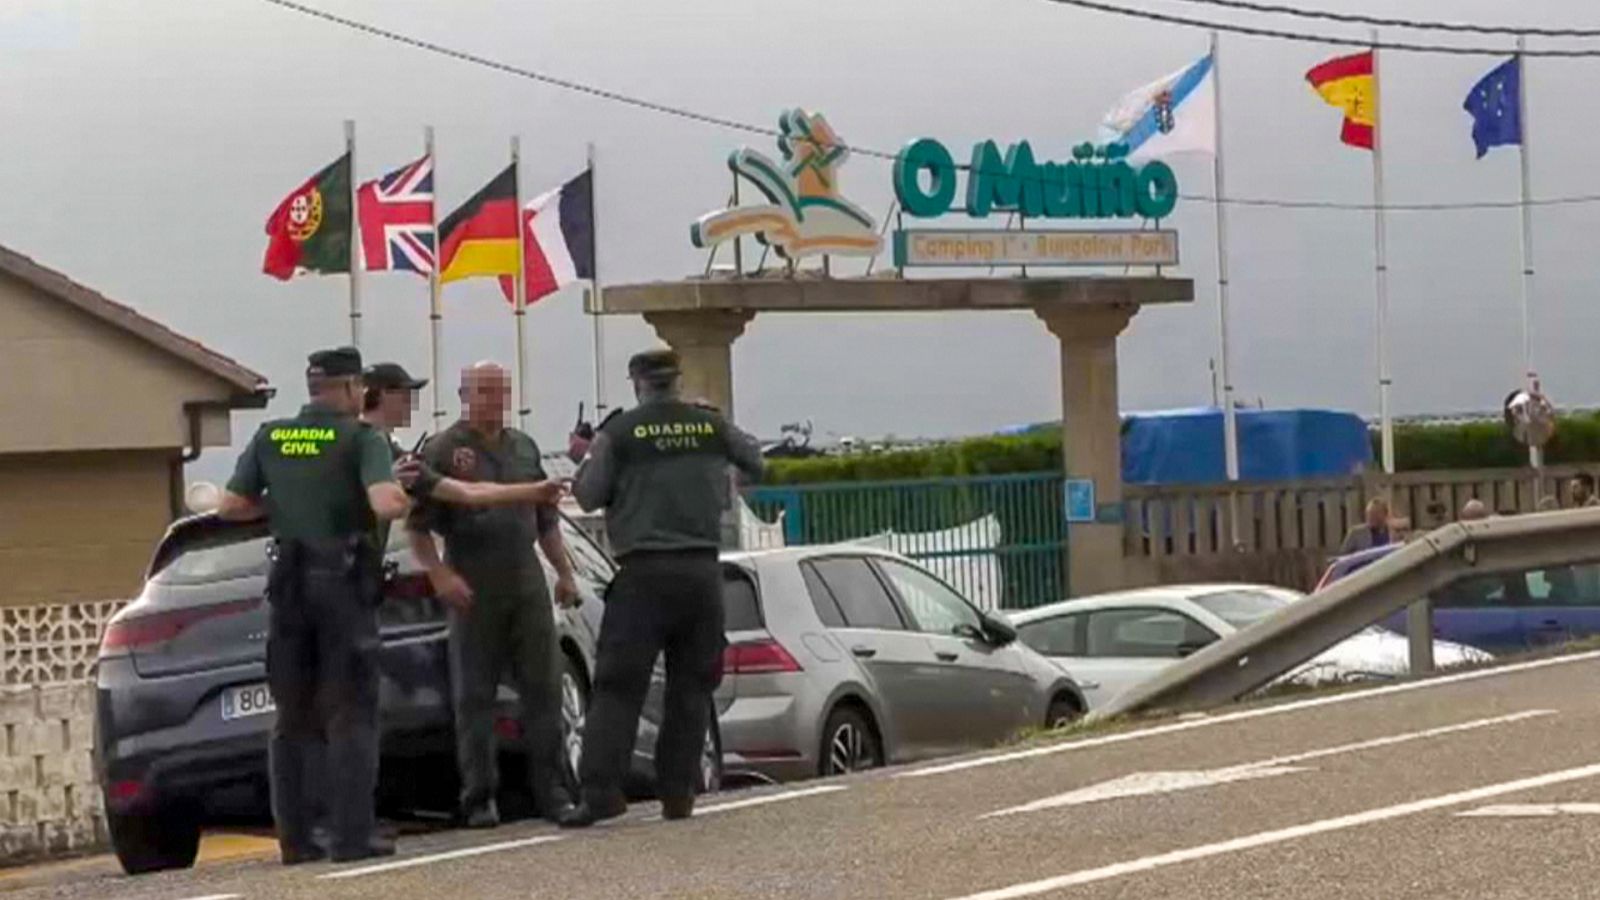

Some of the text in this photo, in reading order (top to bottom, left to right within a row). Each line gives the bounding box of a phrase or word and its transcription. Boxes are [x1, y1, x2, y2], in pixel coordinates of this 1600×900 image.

[894, 138, 956, 218] O
[912, 234, 994, 260] Camping
[1037, 234, 1122, 257] Bungalow
[1131, 234, 1169, 256] Park
[270, 427, 335, 440] GUARDIA
[633, 422, 714, 438] GUARDIA
[281, 441, 320, 455] CIVIL
[655, 435, 699, 451] CIVIL
